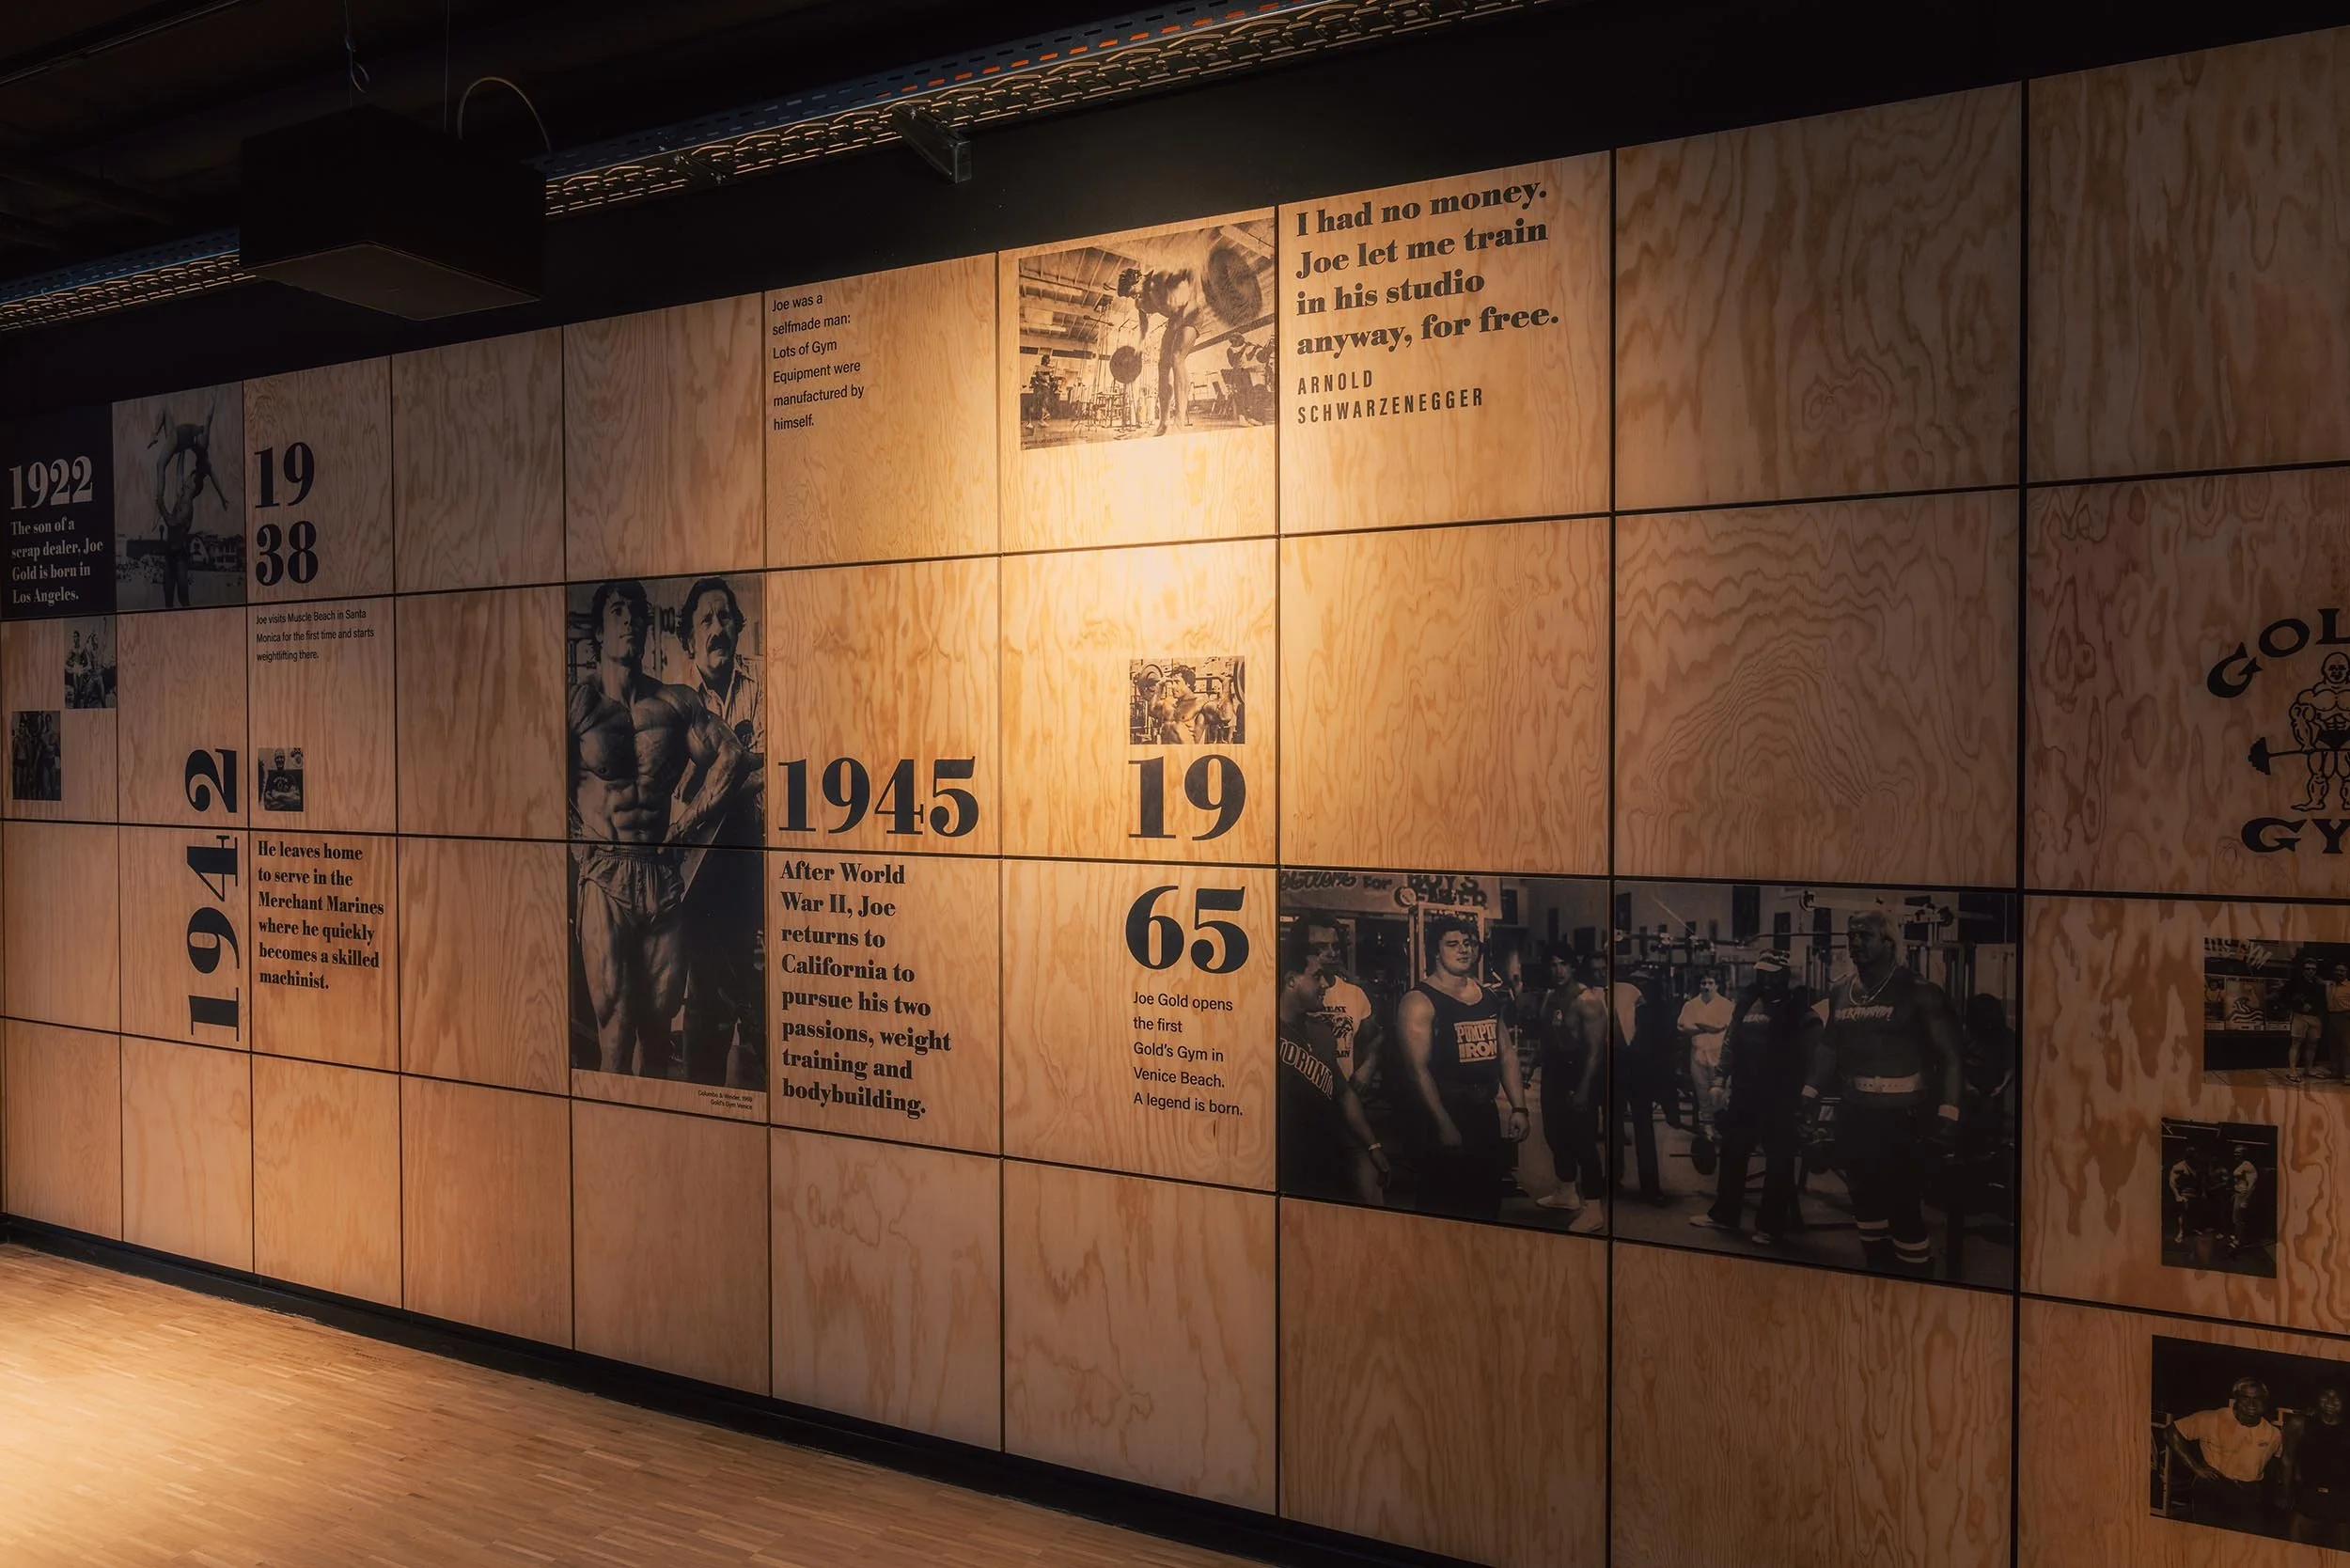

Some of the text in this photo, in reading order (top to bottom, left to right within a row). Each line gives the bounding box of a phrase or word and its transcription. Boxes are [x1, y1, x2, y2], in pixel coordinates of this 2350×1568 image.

[1295, 181, 1547, 237] I had no money.
[1295, 217, 1549, 279] Joe let me train
[772, 294, 823, 312] Joe was a
[1296, 268, 1485, 317] in his studio
[772, 314, 851, 336] selfmade man:
[1297, 306, 1559, 359] anyway, for free.
[773, 340, 838, 359] Lots of Gym
[773, 361, 861, 384] Equipment were
[1297, 369, 1372, 396] ARNOLD
[773, 384, 865, 407] manufactured by
[1297, 387, 1482, 424] SCHWARZENEGGER
[774, 413, 814, 431] himself.
[8, 455, 93, 510] 1922
[254, 442, 315, 509] 19
[10, 516, 75, 536] The son of a
[11, 537, 103, 562] scrap dealer, Joe
[255, 520, 319, 587] 38
[12, 561, 91, 581] Gold is born in
[12, 586, 79, 607] Los Angeles.
[256, 608, 367, 625] Joe visits Muscle Beach in Santa
[256, 627, 375, 644] Monica for the first time and starts
[256, 649, 320, 664] weightlifting there.
[777, 756, 979, 838] 1945
[1127, 754, 1246, 841] 19
[258, 839, 364, 861] He leaves home
[258, 867, 353, 886] to serve in the
[779, 860, 906, 885] After World
[183, 747, 241, 1043] 1942
[258, 890, 384, 916] Merchant Marines
[780, 890, 896, 919] War II, Joe
[258, 917, 375, 947] where he quickly
[781, 925, 885, 949] returns to
[1125, 885, 1250, 975] 65
[258, 941, 380, 968] becomes a skilled
[259, 969, 329, 990] machinist.
[781, 953, 916, 983] California to
[781, 991, 932, 1017] pursue his two
[1133, 991, 1233, 1012] Joe Gold opens
[1133, 1015, 1183, 1033] the first
[781, 1019, 952, 1056] passions, weight
[782, 1048, 913, 1082] training and
[1177, 1045, 1208, 1063] Gym
[1212, 1047, 1224, 1062] in
[1133, 1066, 1225, 1089] Venice Beach.
[782, 1077, 926, 1120] bodybuilding.
[1133, 1091, 1243, 1116] A legend is born.
